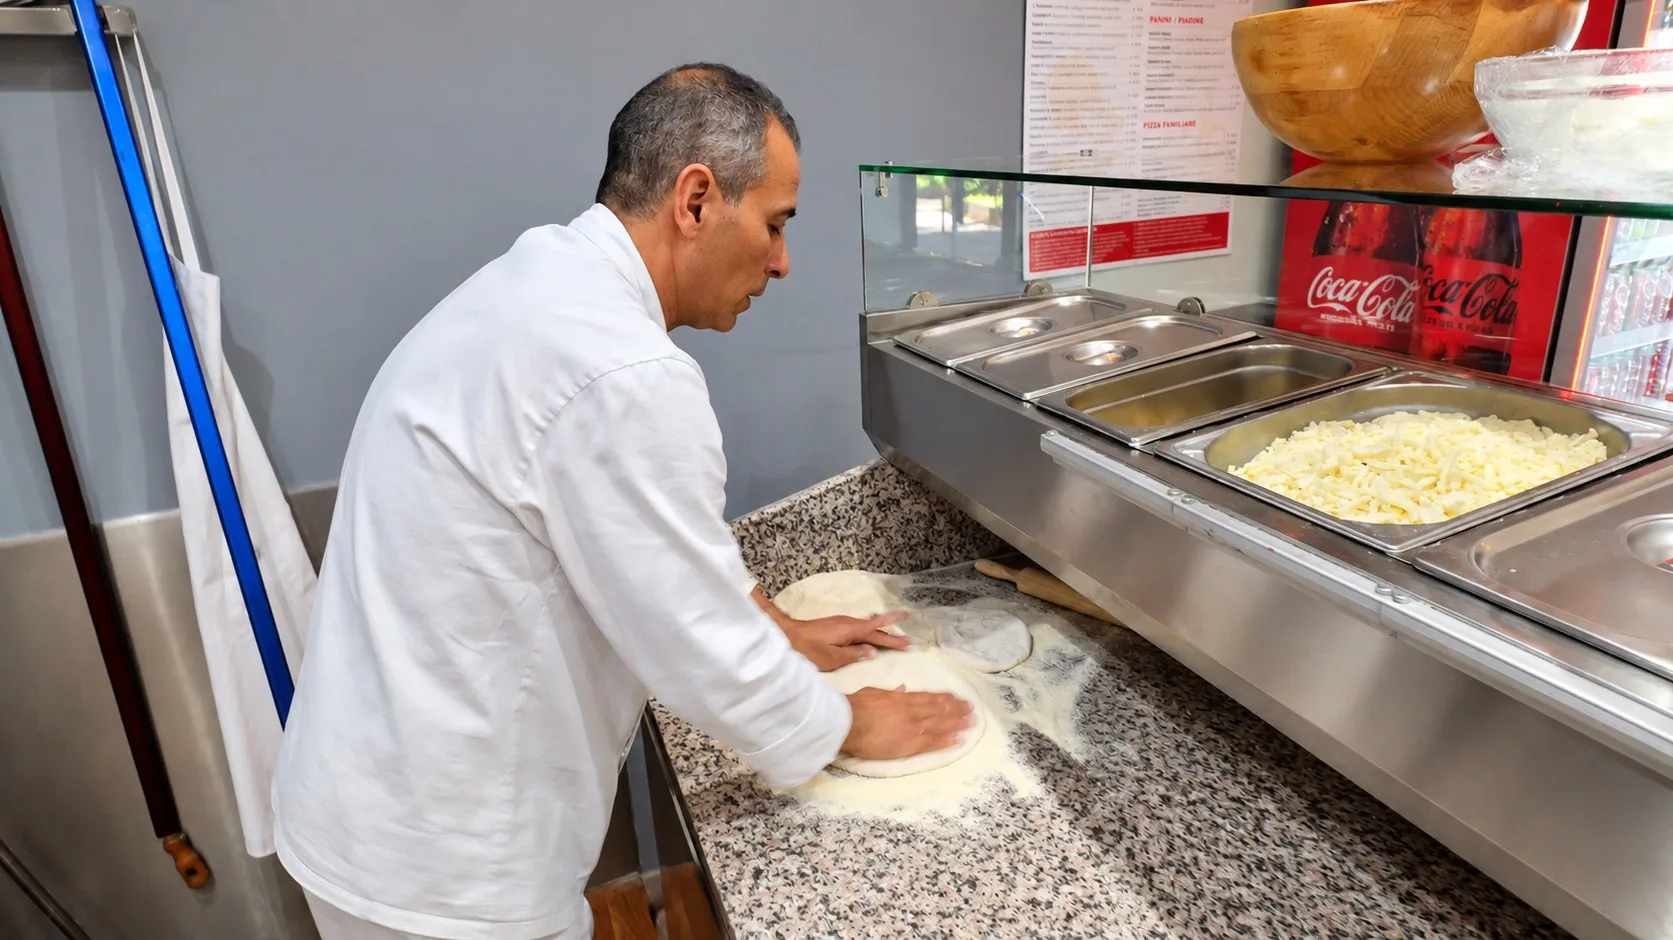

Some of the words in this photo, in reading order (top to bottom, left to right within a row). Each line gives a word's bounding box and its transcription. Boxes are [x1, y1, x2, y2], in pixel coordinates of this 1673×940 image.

[1149, 16, 1172, 24] PANINI
[1143, 120, 1161, 129] PIZZA
[1162, 119, 1196, 128] FAMILIARE
[1307, 266, 1420, 323] Coca-Cola
